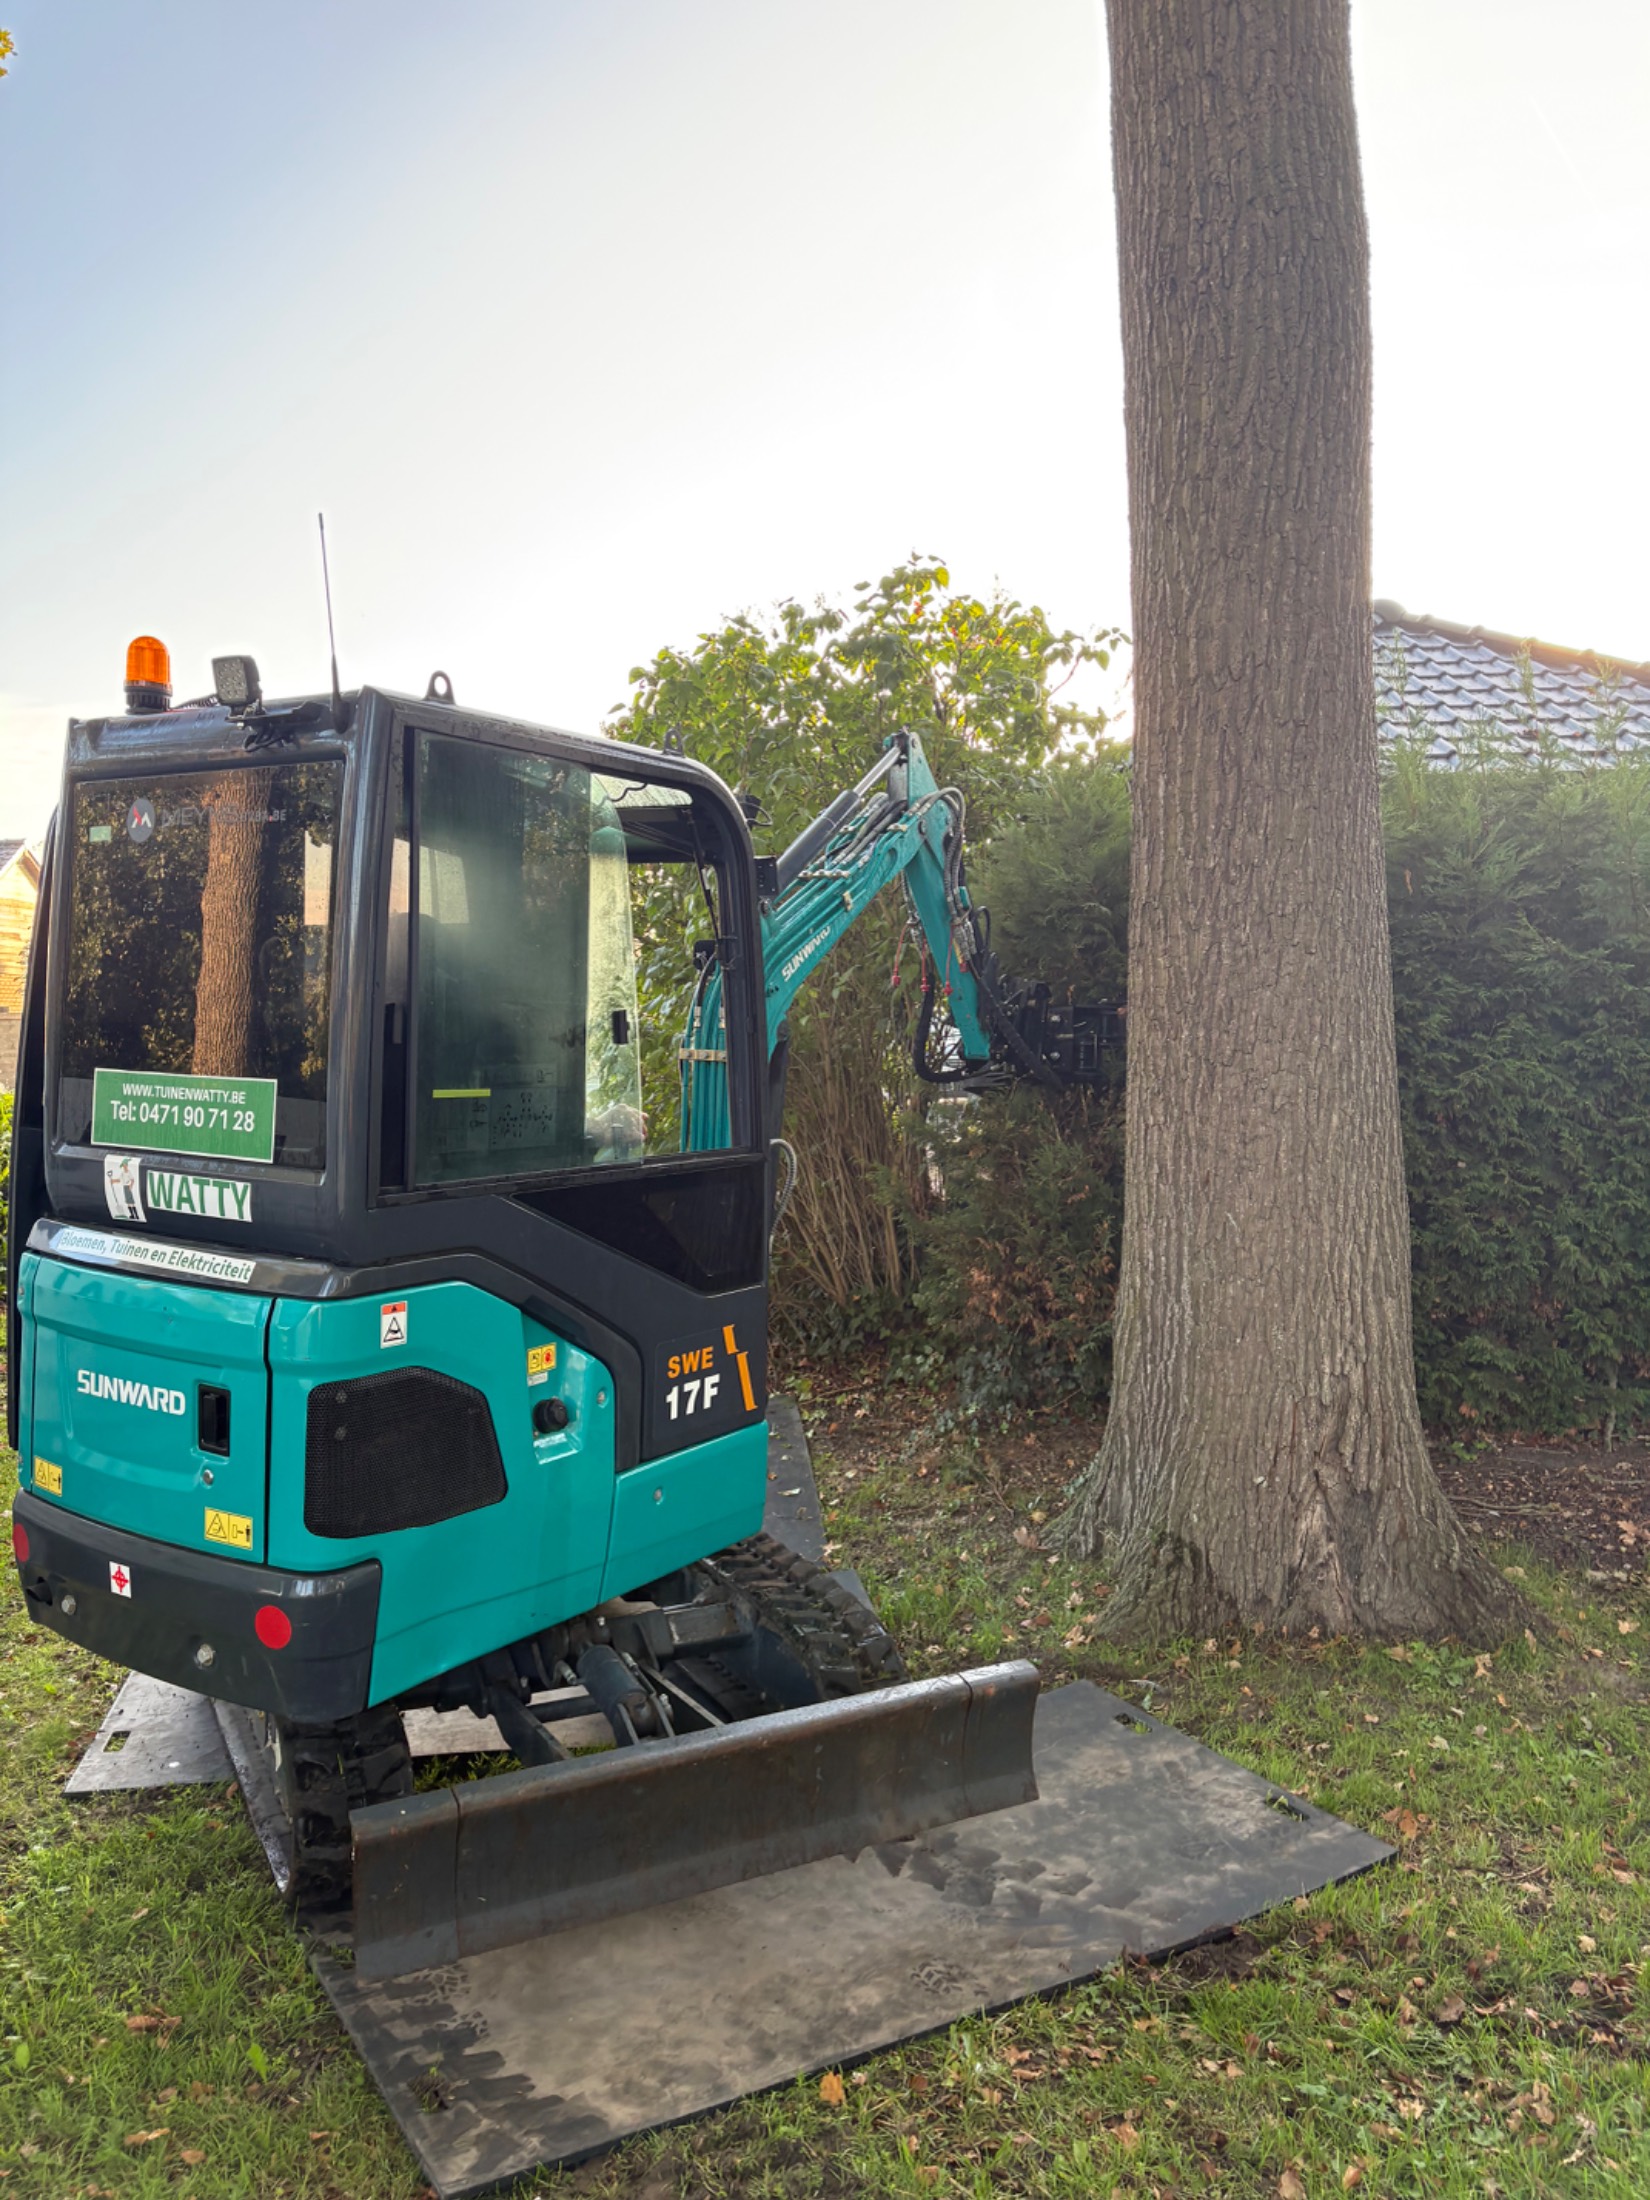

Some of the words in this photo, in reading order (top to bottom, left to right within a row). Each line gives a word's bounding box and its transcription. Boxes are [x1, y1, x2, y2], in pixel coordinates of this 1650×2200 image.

[110, 1100, 136, 1121] Tel:
[139, 1102, 179, 1125] 0471
[183, 1106, 205, 1127] 90
[207, 1108, 228, 1129] 71
[232, 1110, 255, 1132] 28
[122, 1083, 246, 1104] WWW.TUINENWATTY.BE
[149, 1172, 250, 1219] WATTY
[61, 1231, 107, 1254] Bloemen,
[110, 1239, 149, 1260] Tuinen
[150, 1250, 167, 1262] en
[168, 1250, 251, 1280] Elektriciteit
[667, 1346, 714, 1378] SWE
[77, 1369, 186, 1416] SUNWARD
[666, 1373, 720, 1420] 17F
